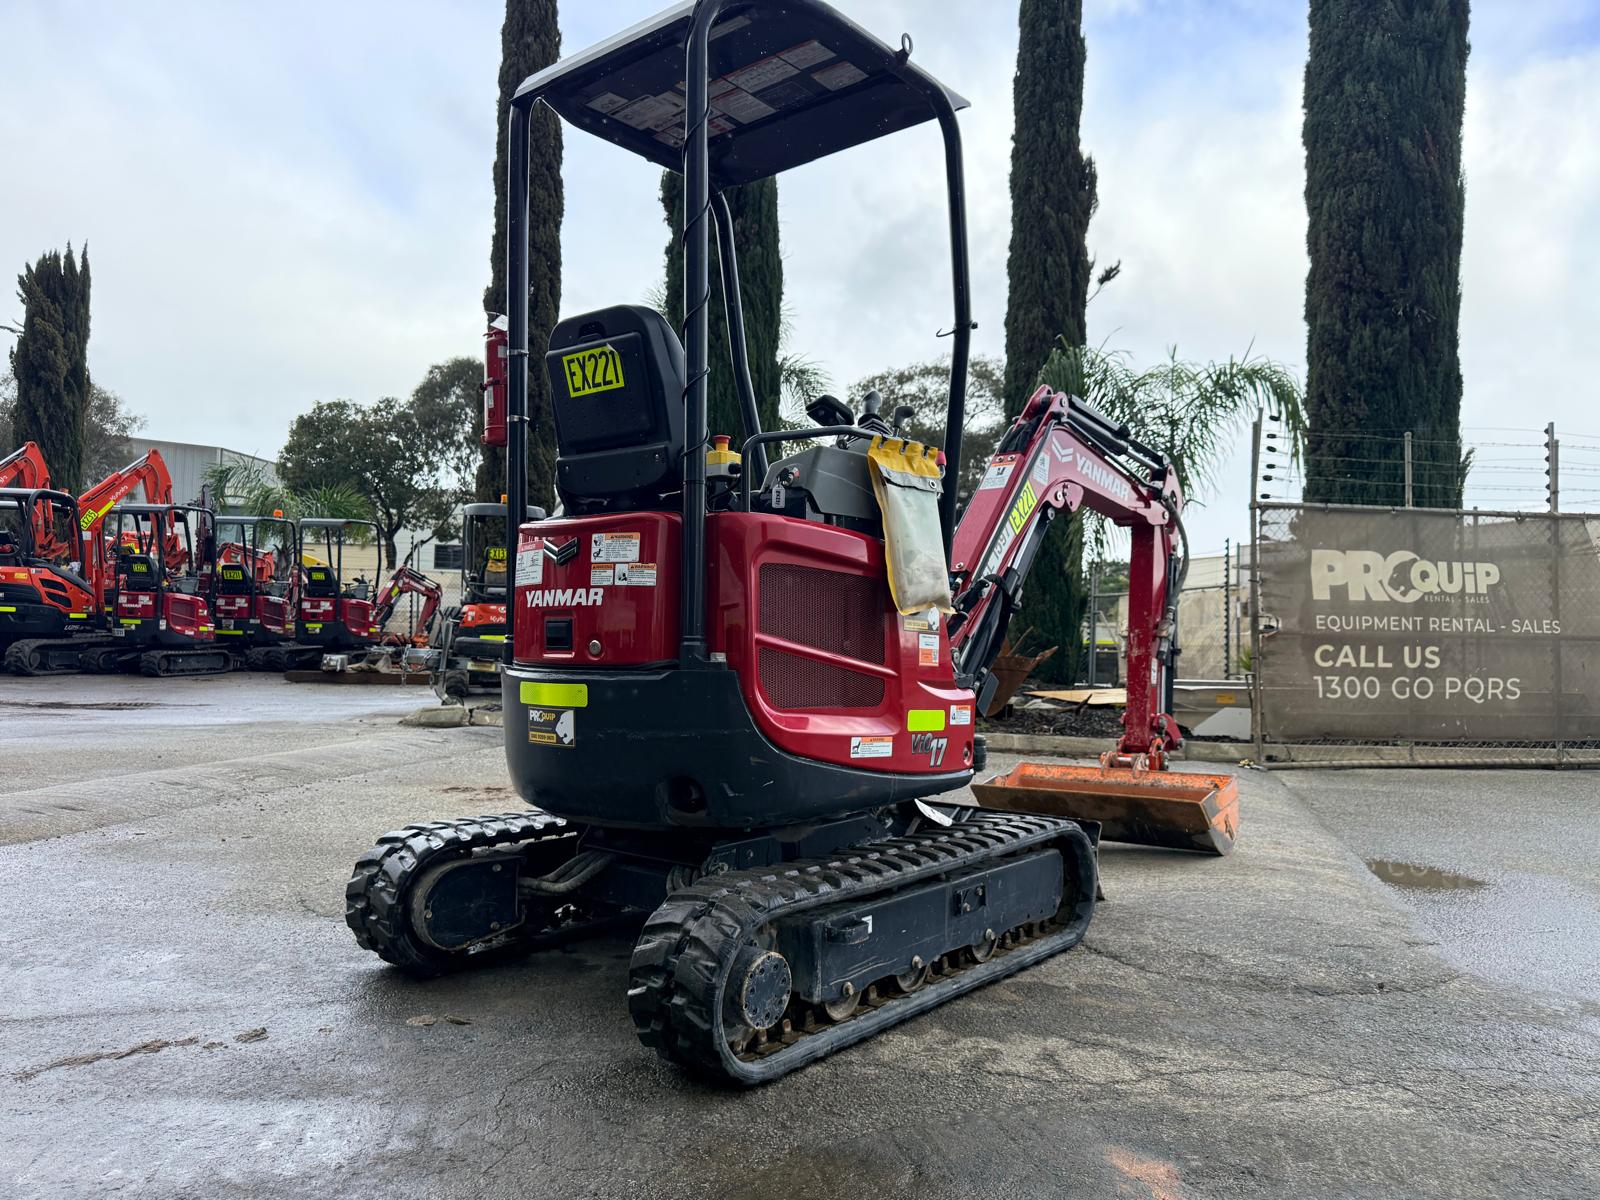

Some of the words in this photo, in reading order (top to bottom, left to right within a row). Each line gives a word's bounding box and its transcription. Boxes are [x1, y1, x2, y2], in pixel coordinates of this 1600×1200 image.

[566, 350, 620, 393] EX221
[1076, 453, 1130, 502] YANMAR
[1010, 484, 1036, 530] EX221
[525, 588, 604, 608] YANMAR
[1424, 594, 1455, 604] RENTAL
[1465, 595, 1490, 604] SALES
[1315, 614, 1423, 632] EQUIPMENT
[1429, 616, 1496, 633] RENTAL
[1511, 619, 1562, 634] SALES
[1314, 644, 1393, 668] CALL
[1403, 646, 1441, 669] US
[1313, 676, 1381, 699] 1300
[1391, 676, 1434, 699] GO
[1445, 677, 1521, 704] PQRS
